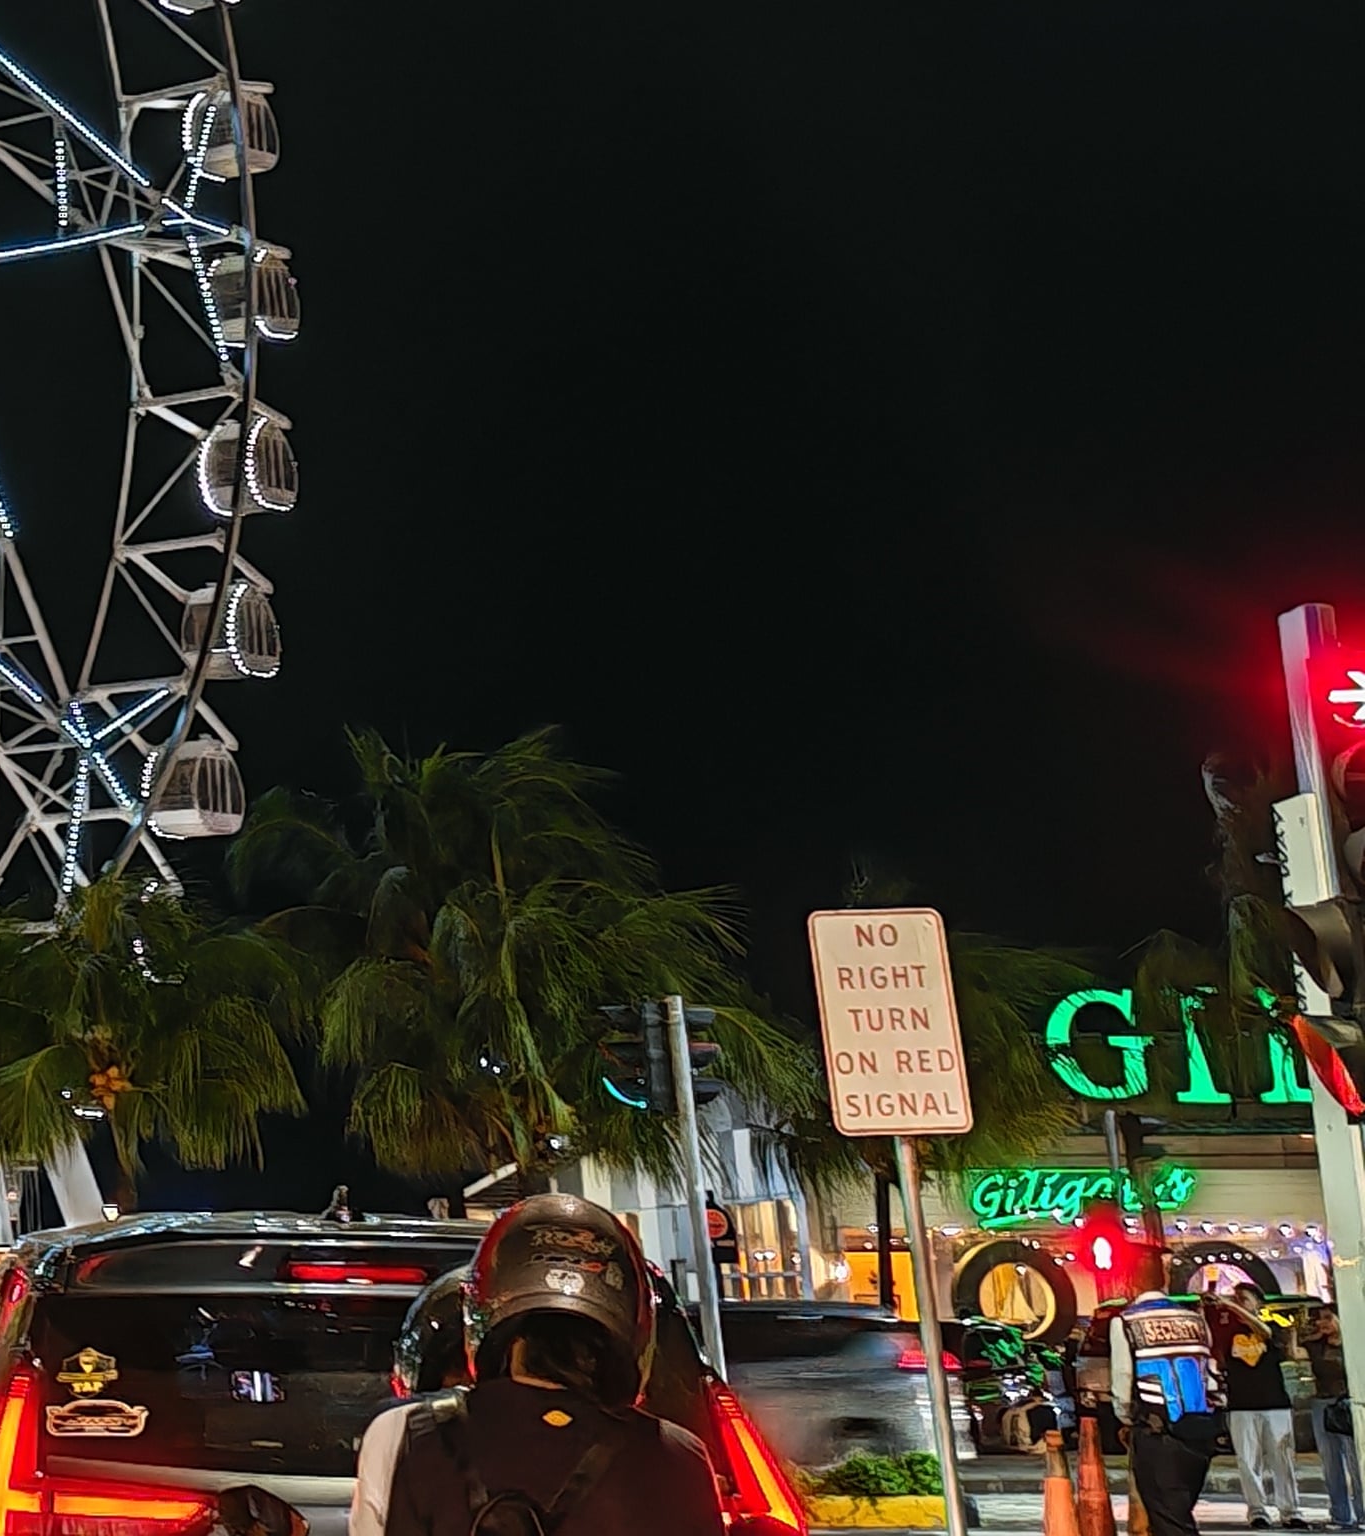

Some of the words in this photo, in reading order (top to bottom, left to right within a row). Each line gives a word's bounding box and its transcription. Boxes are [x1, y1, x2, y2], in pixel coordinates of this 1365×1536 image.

[854, 923, 899, 948] NO
[836, 964, 927, 991] RIGHT
[847, 1007, 931, 1033] TURN
[835, 1050, 880, 1076] ON
[895, 1048, 956, 1074] RED
[845, 1091, 959, 1118] SIGNAL
